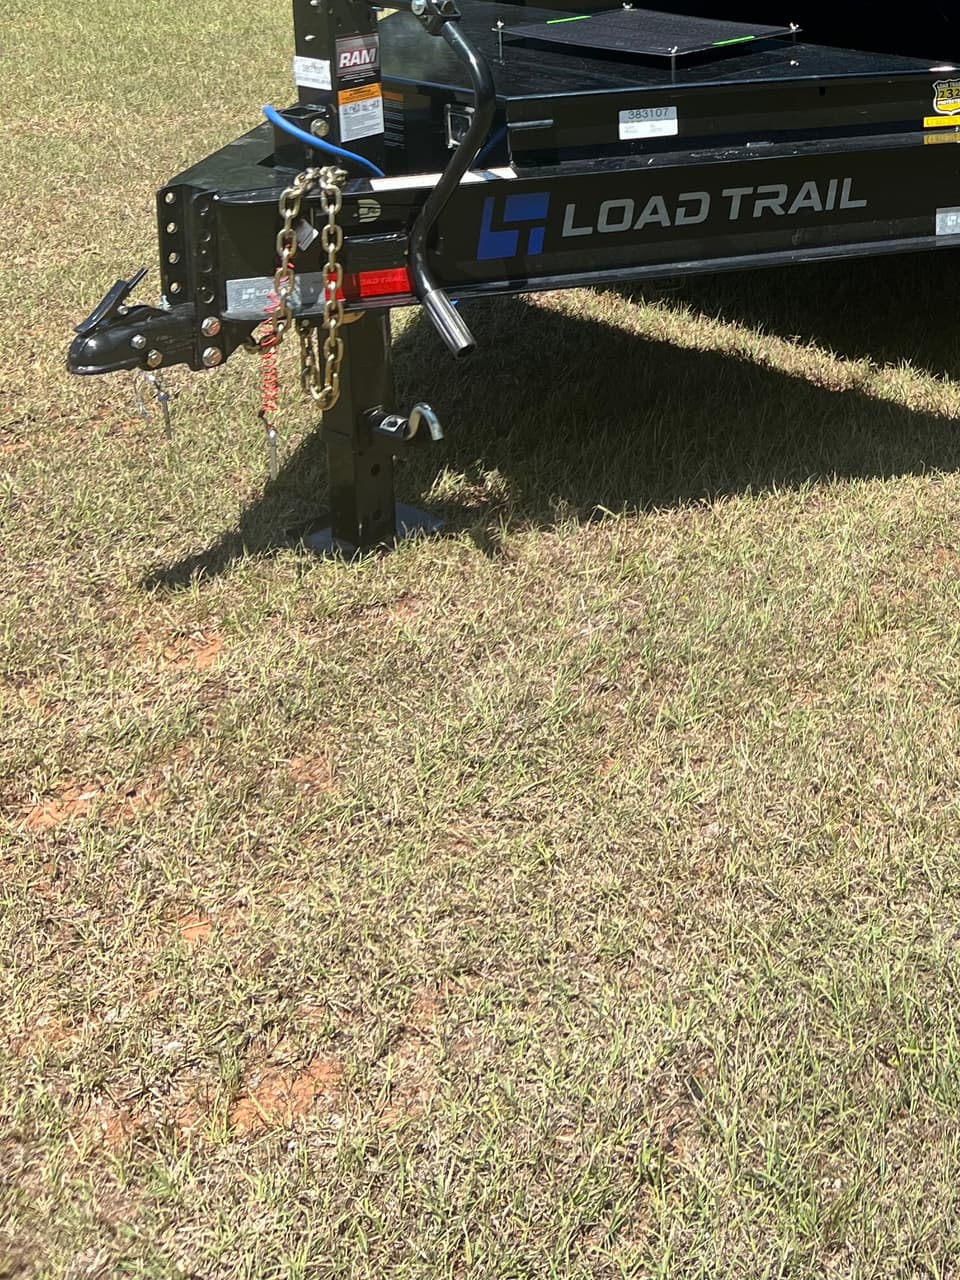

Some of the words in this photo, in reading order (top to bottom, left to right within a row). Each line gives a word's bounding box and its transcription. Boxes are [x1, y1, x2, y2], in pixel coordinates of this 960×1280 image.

[339, 47, 377, 68] RAM
[627, 107, 670, 120] 383107
[561, 191, 712, 238] LOAD
[721, 177, 868, 220] TRAIL
